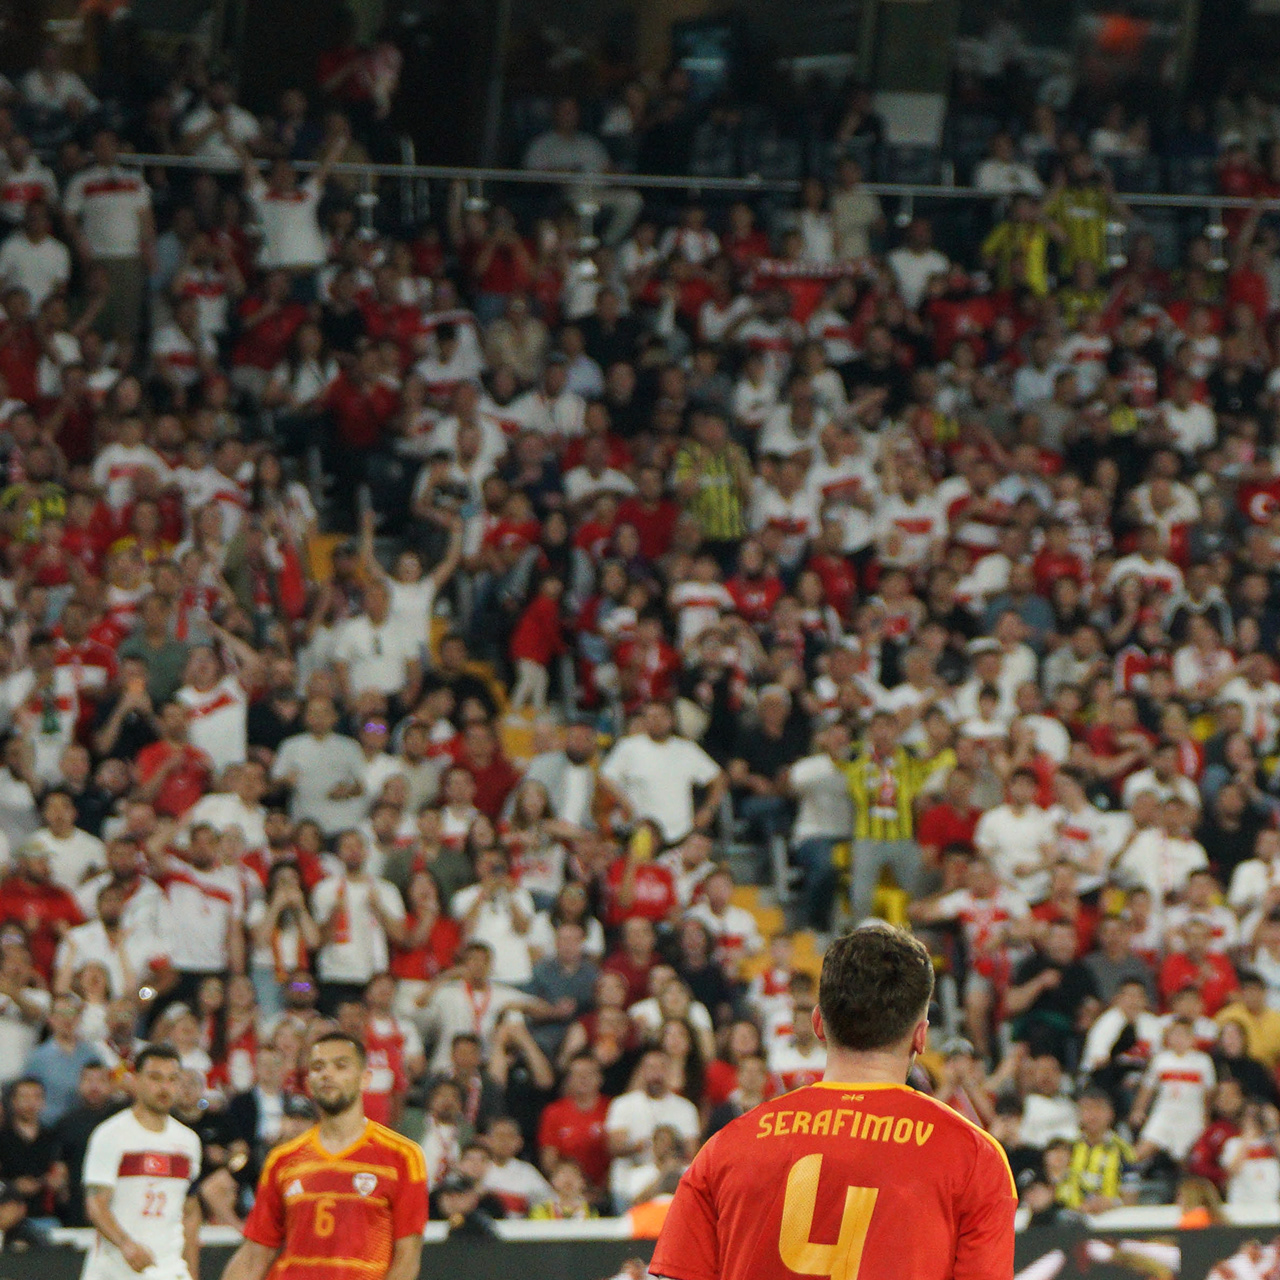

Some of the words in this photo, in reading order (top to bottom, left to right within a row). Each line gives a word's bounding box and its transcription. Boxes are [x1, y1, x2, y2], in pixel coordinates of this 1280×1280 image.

[757, 1109, 934, 1146] SERAFIMOV
[141, 1191, 167, 1217] 22
[314, 1199, 336, 1237] 6
